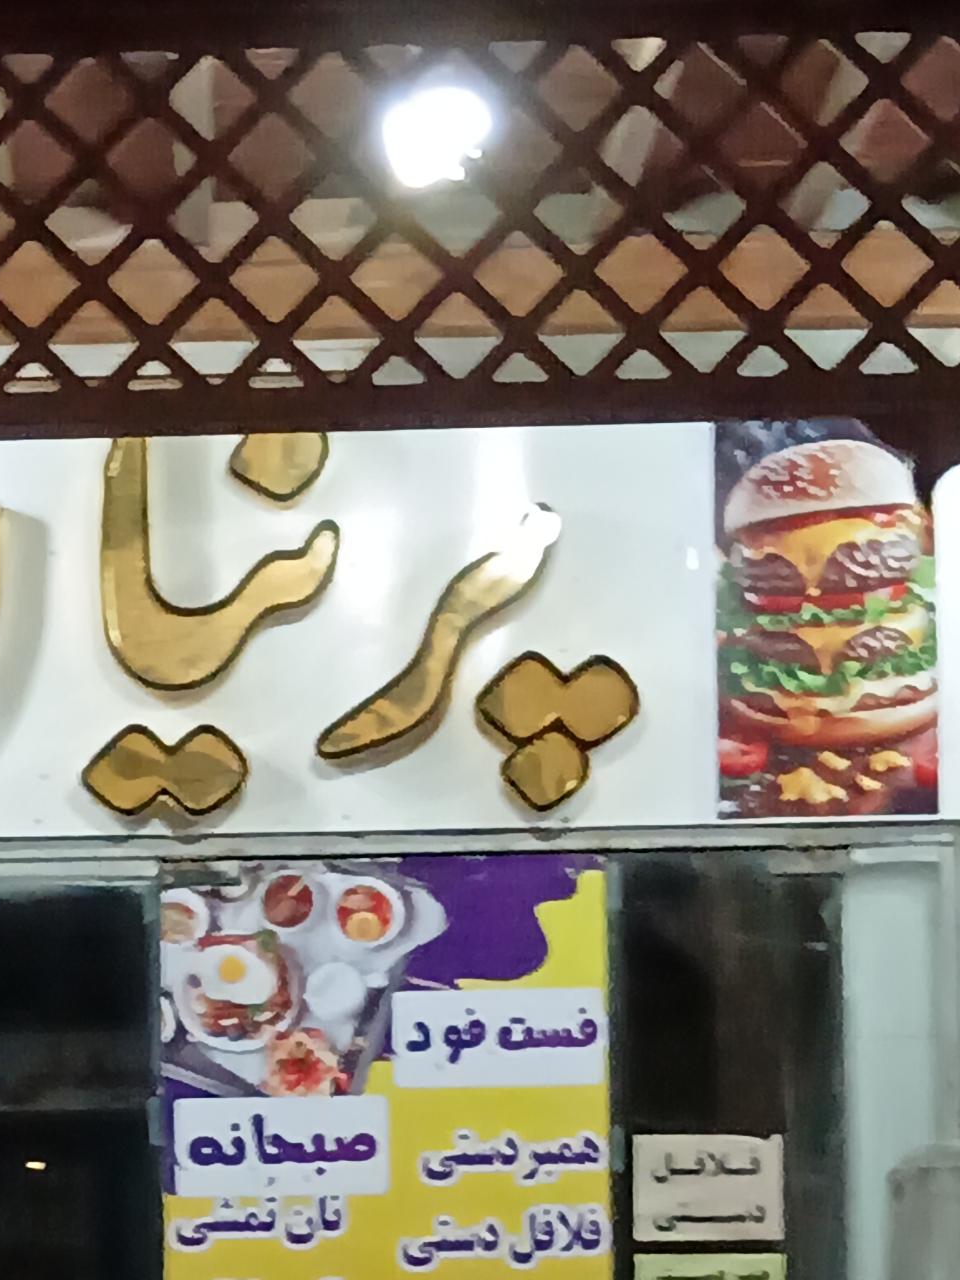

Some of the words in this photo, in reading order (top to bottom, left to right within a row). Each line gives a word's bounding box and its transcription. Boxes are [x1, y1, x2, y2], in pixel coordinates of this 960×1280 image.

[405, 1008, 487, 1064] فود
[498, 1007, 598, 1050] فست
[189, 1113, 377, 1176] صبحانه
[422, 1134, 519, 1181] دستی
[285, 1194, 341, 1244] نان
[403, 1216, 500, 1266] دستی
[508, 1207, 602, 1264] فلافل
